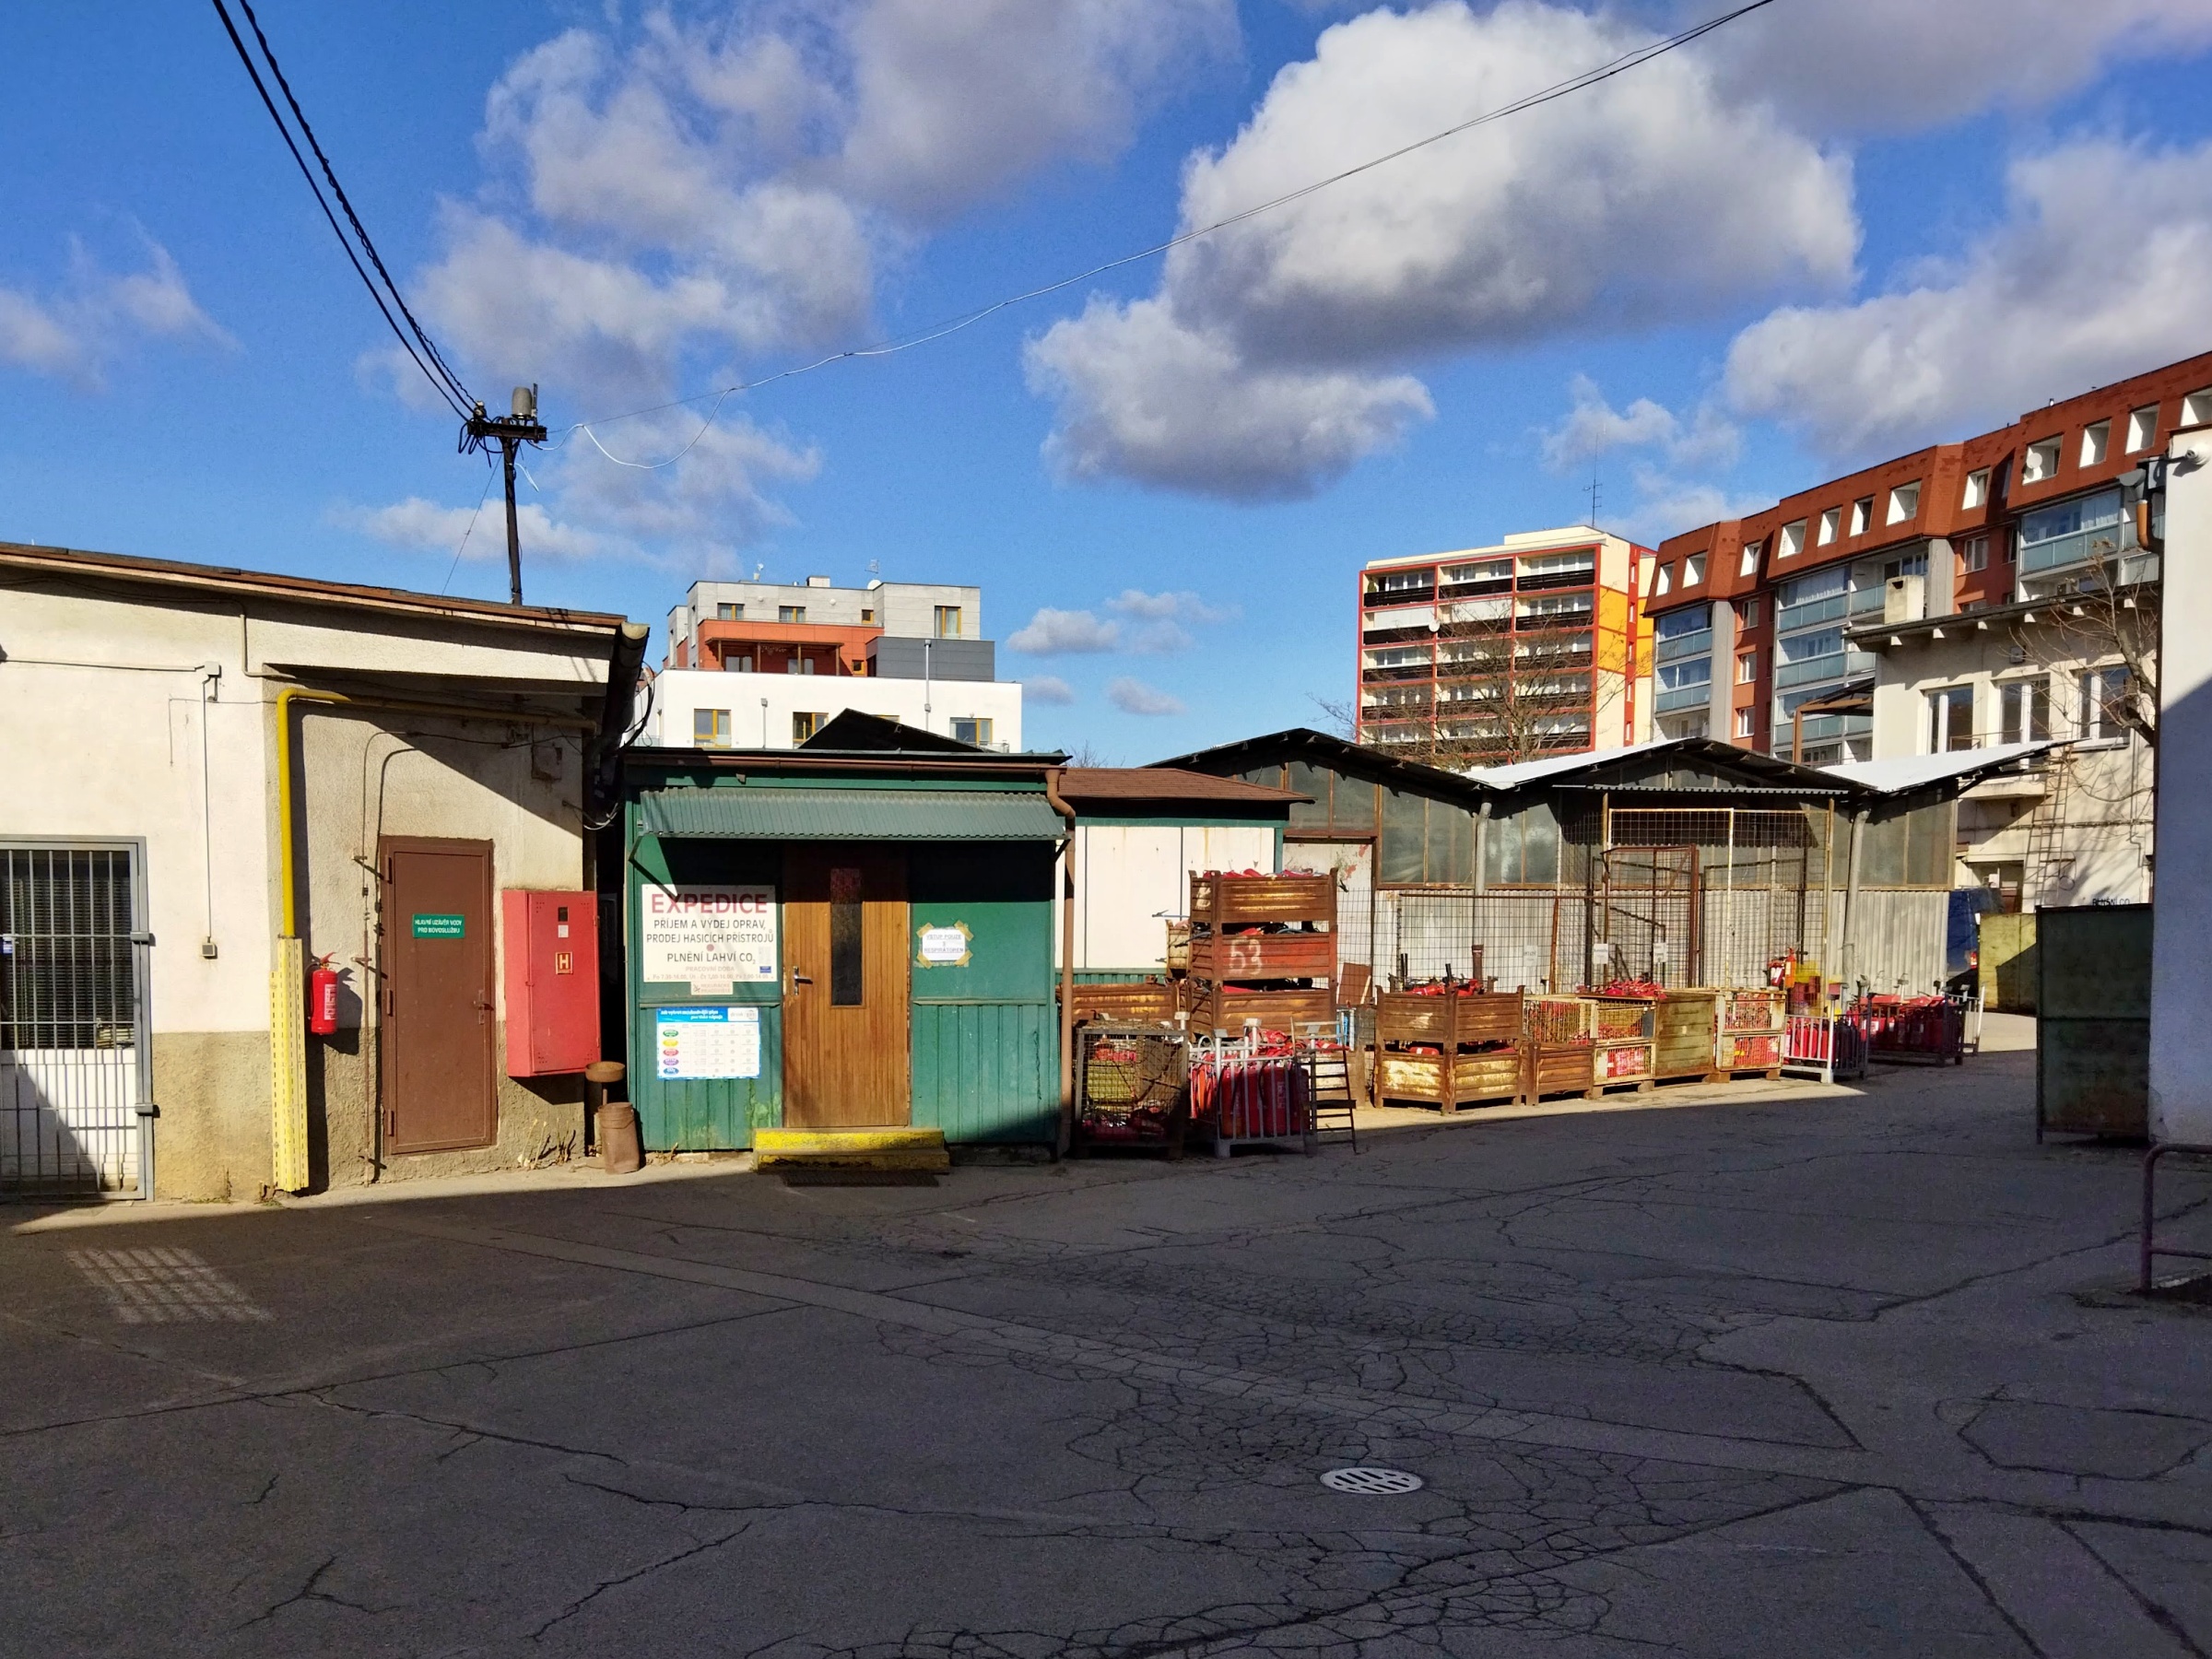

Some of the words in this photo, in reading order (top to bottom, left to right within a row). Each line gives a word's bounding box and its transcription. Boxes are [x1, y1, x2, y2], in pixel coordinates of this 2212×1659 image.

[652, 893, 768, 913] EXPEDICE
[653, 917, 688, 929] PŘÍJEM
[690, 920, 698, 929] A
[700, 917, 730, 929] VÝDEJ
[733, 919, 767, 931] OPRAV,
[646, 934, 681, 943] PRODEJ
[683, 931, 724, 943] HASICÍCH
[726, 929, 774, 943] PŘÍSTROJŮ
[559, 954, 570, 970] H
[666, 950, 703, 962] PLNĚNÍ
[706, 950, 736, 962] LAHVÍ
[1230, 935, 1263, 975] 53
